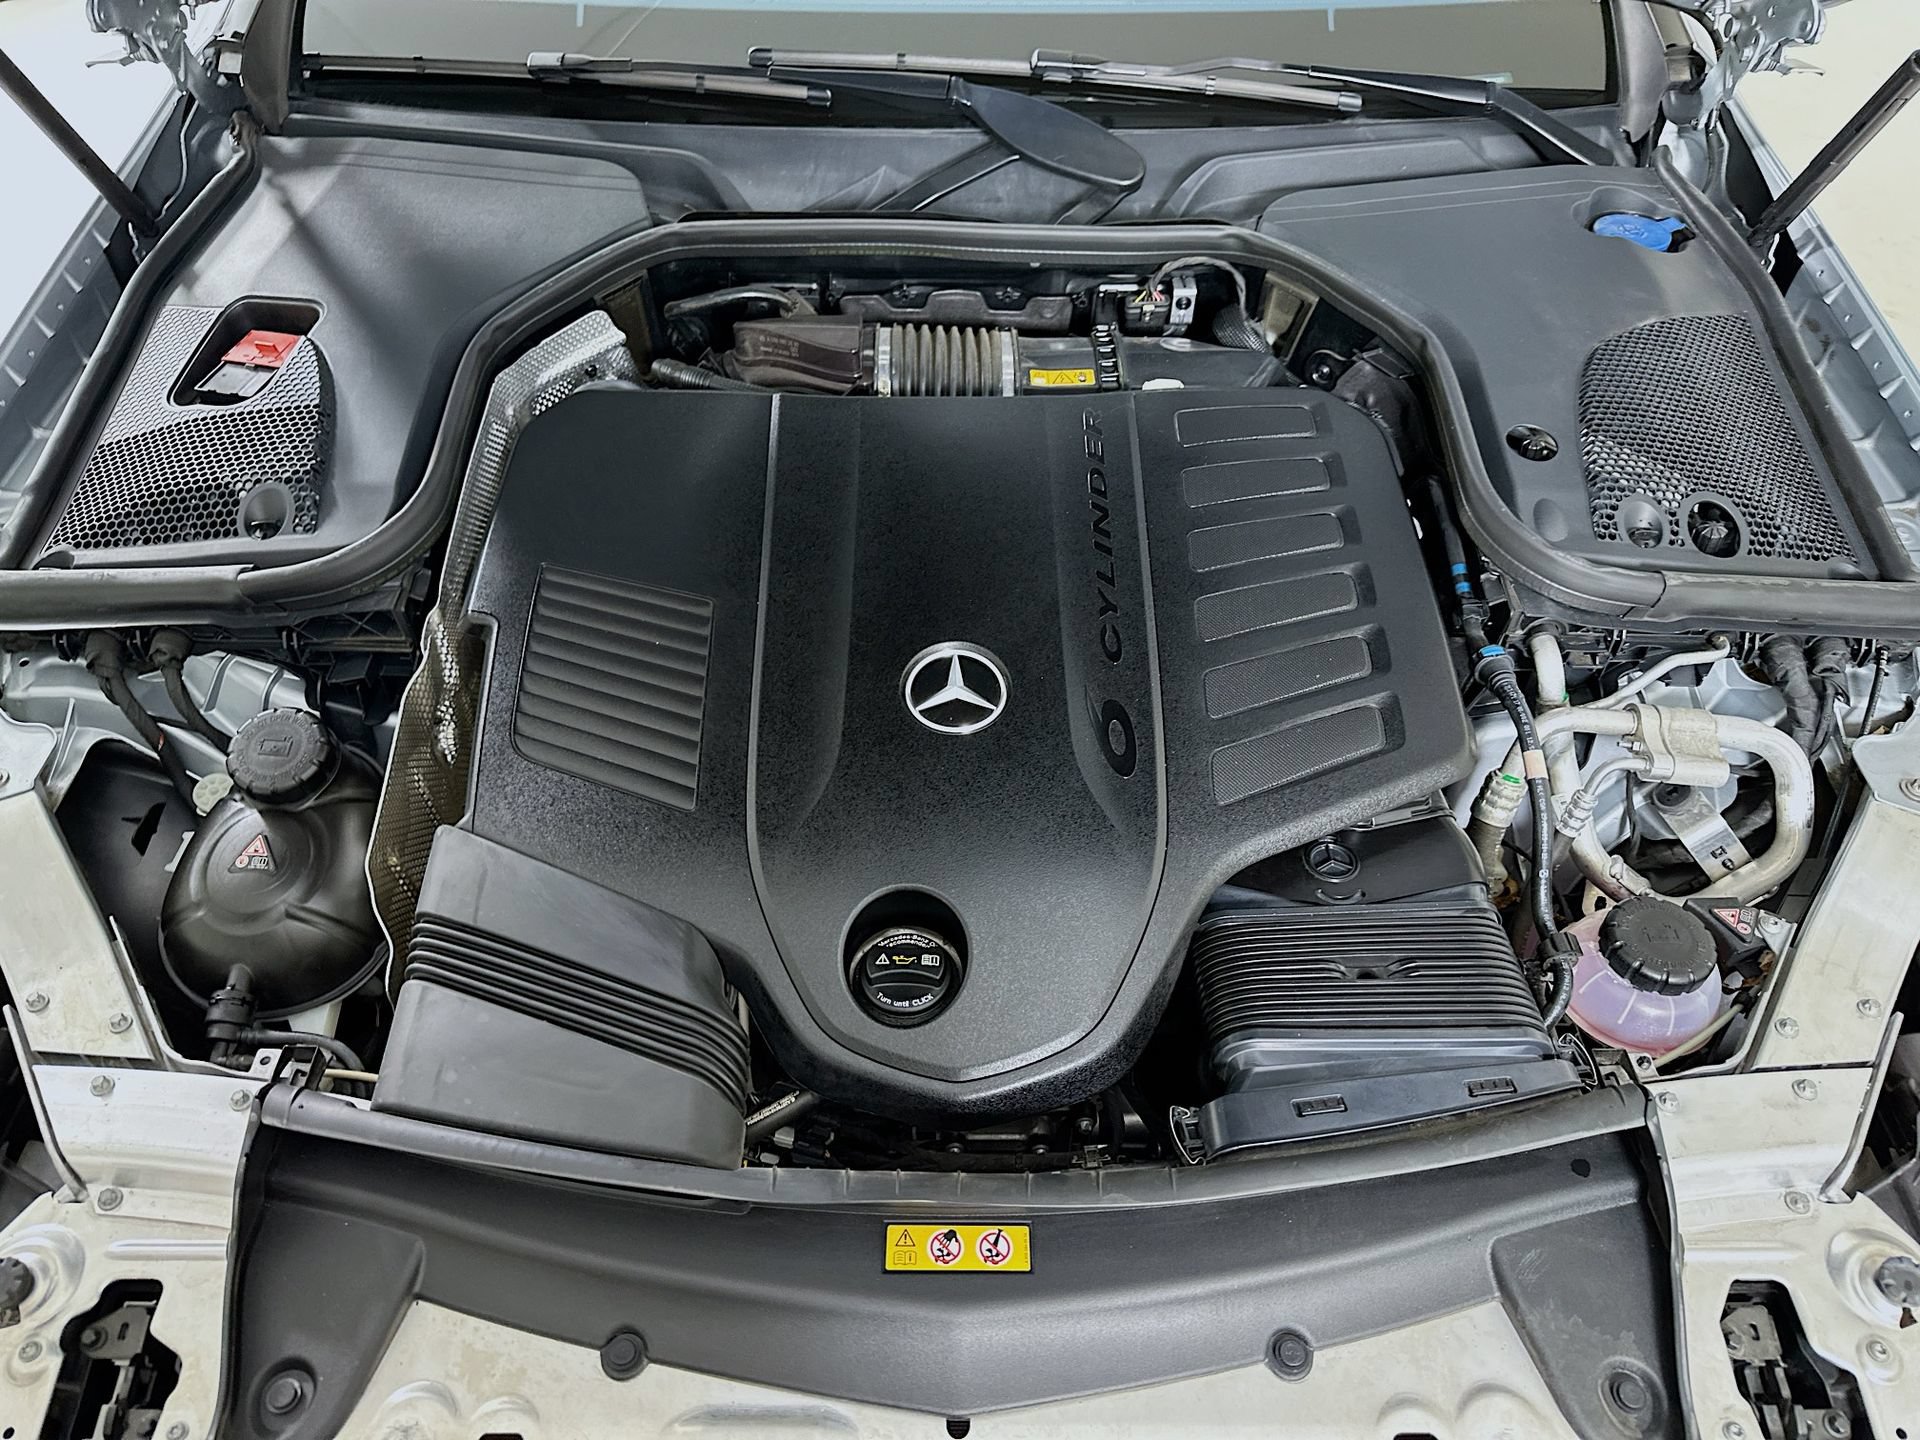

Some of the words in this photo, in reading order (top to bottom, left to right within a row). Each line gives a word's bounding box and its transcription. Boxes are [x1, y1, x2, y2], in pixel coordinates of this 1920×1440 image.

[1082, 407, 1124, 666] CYLINDER
[1084, 682, 1138, 779] 6
[876, 992, 892, 1005] Turn
[893, 1000, 910, 1008] until
[911, 993, 934, 1007] CLICK
